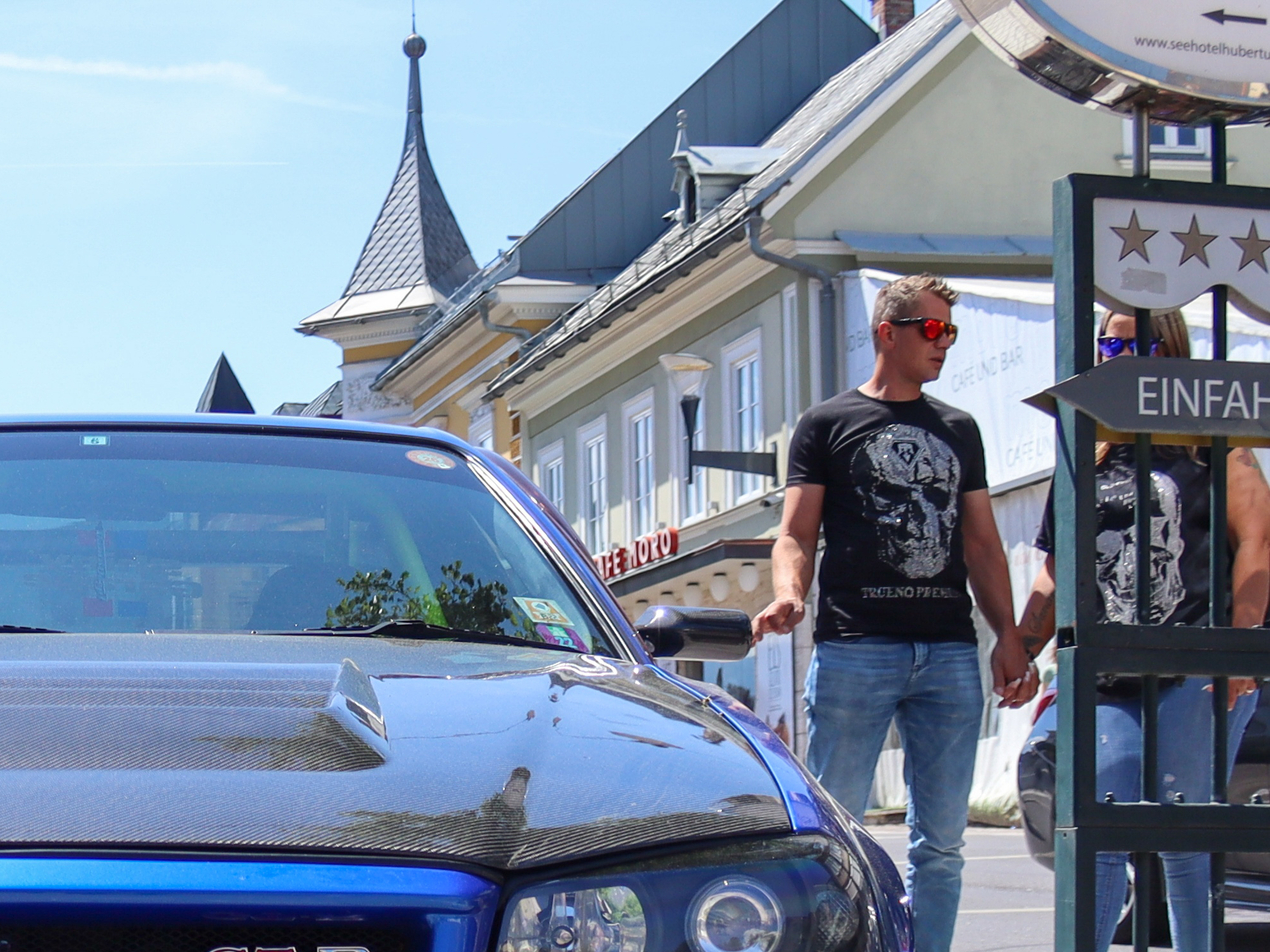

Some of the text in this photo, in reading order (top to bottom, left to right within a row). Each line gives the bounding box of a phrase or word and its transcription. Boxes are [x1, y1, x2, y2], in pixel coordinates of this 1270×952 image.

[1000, 345, 1025, 373] BAR
[595, 528, 675, 580] AFE MORO
